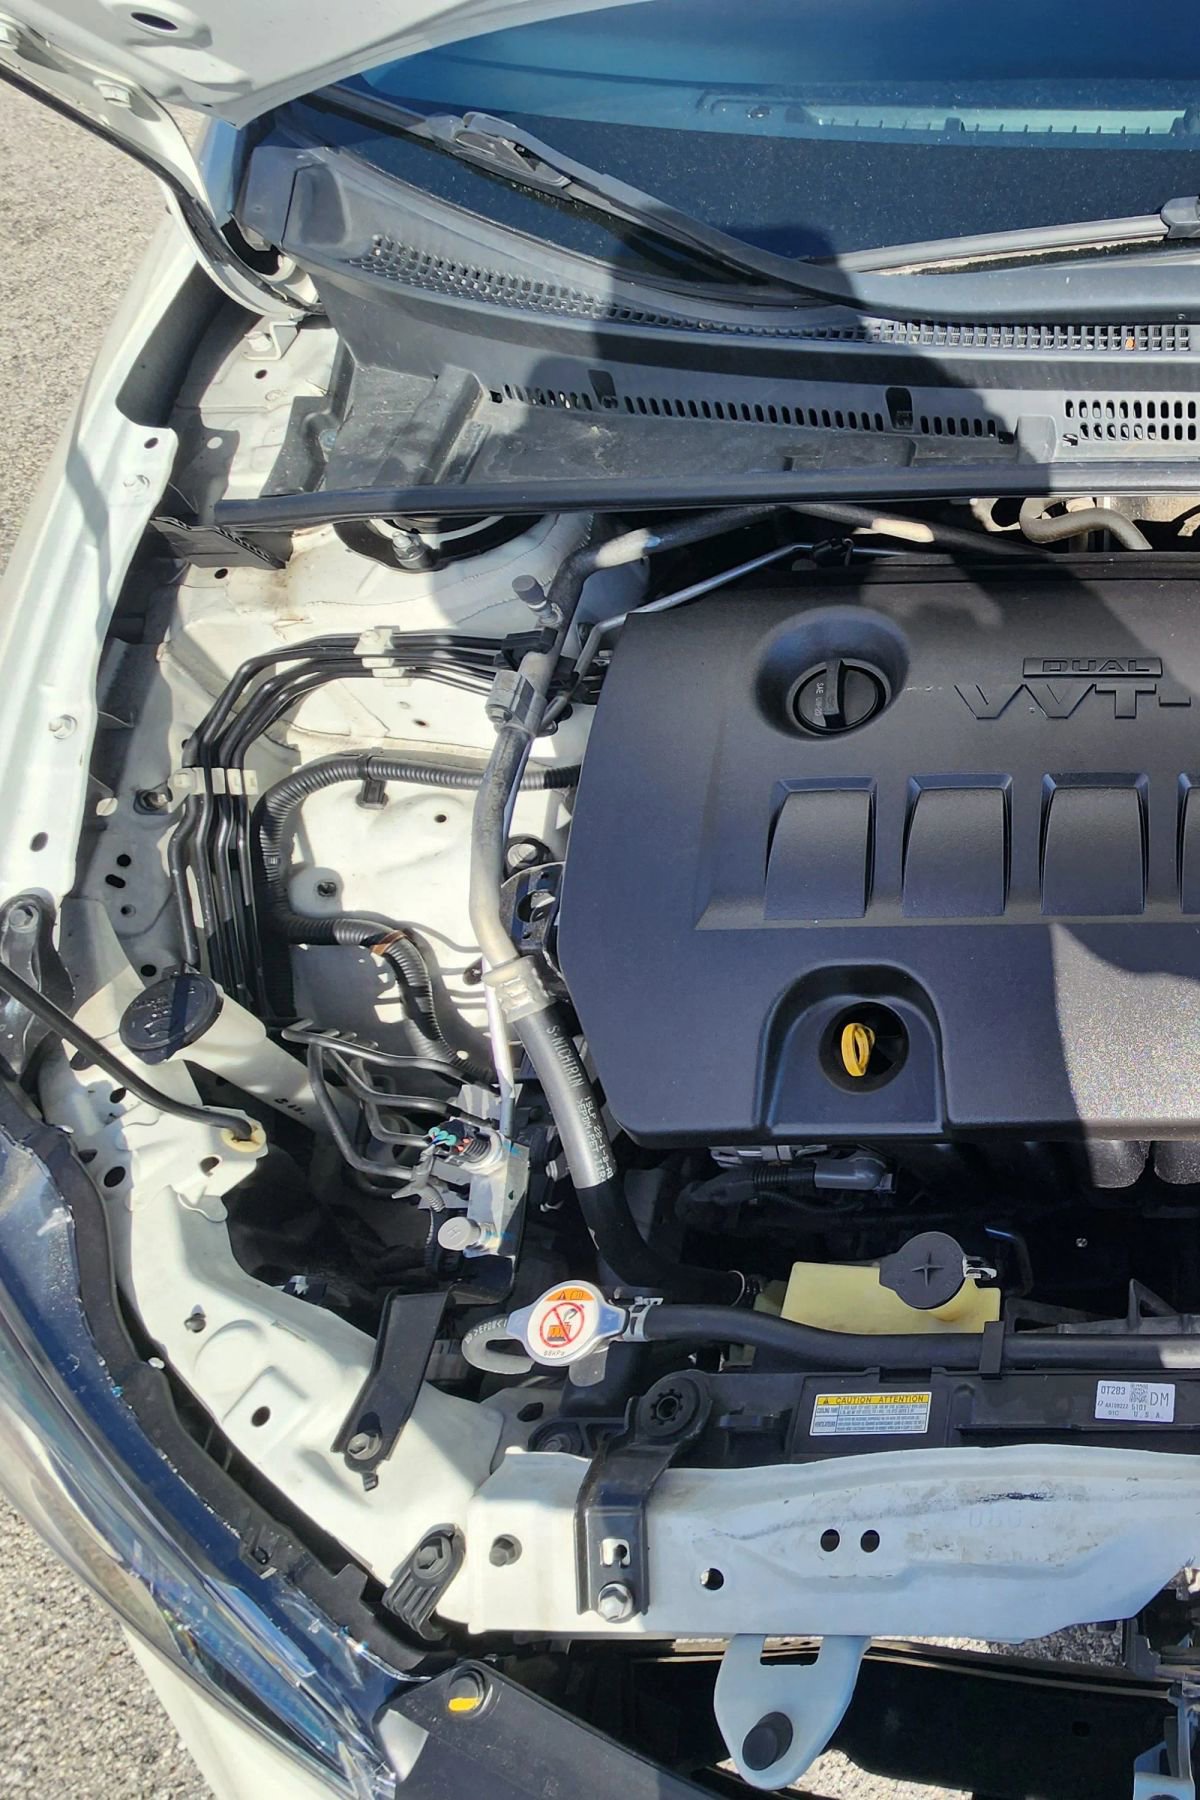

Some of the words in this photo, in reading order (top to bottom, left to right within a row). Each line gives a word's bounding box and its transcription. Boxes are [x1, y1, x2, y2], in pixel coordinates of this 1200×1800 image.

[1041, 659, 1151, 673] DUAL
[815, 682, 825, 694] SAE
[878, 1396, 924, 1404] ATTENTION
[1150, 1391, 1170, 1407] DM
